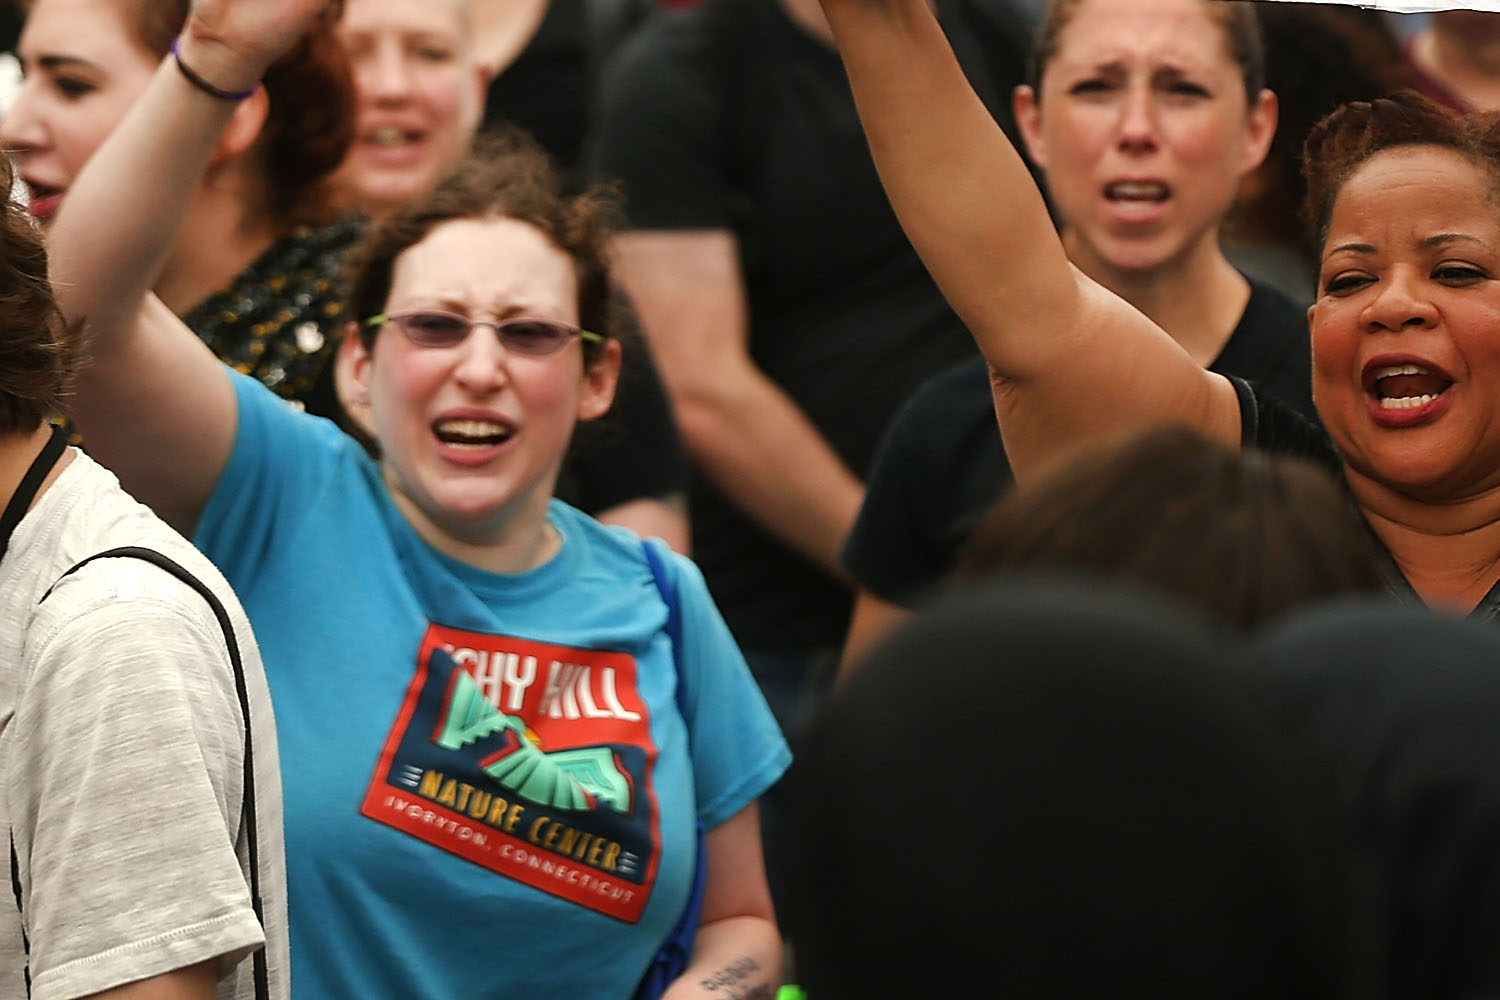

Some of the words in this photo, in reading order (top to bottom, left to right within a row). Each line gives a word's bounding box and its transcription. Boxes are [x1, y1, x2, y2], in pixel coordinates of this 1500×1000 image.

[418, 769, 525, 833] NATURE
[528, 816, 621, 871] CENTER
[498, 844, 635, 903] CONNECTICUT
